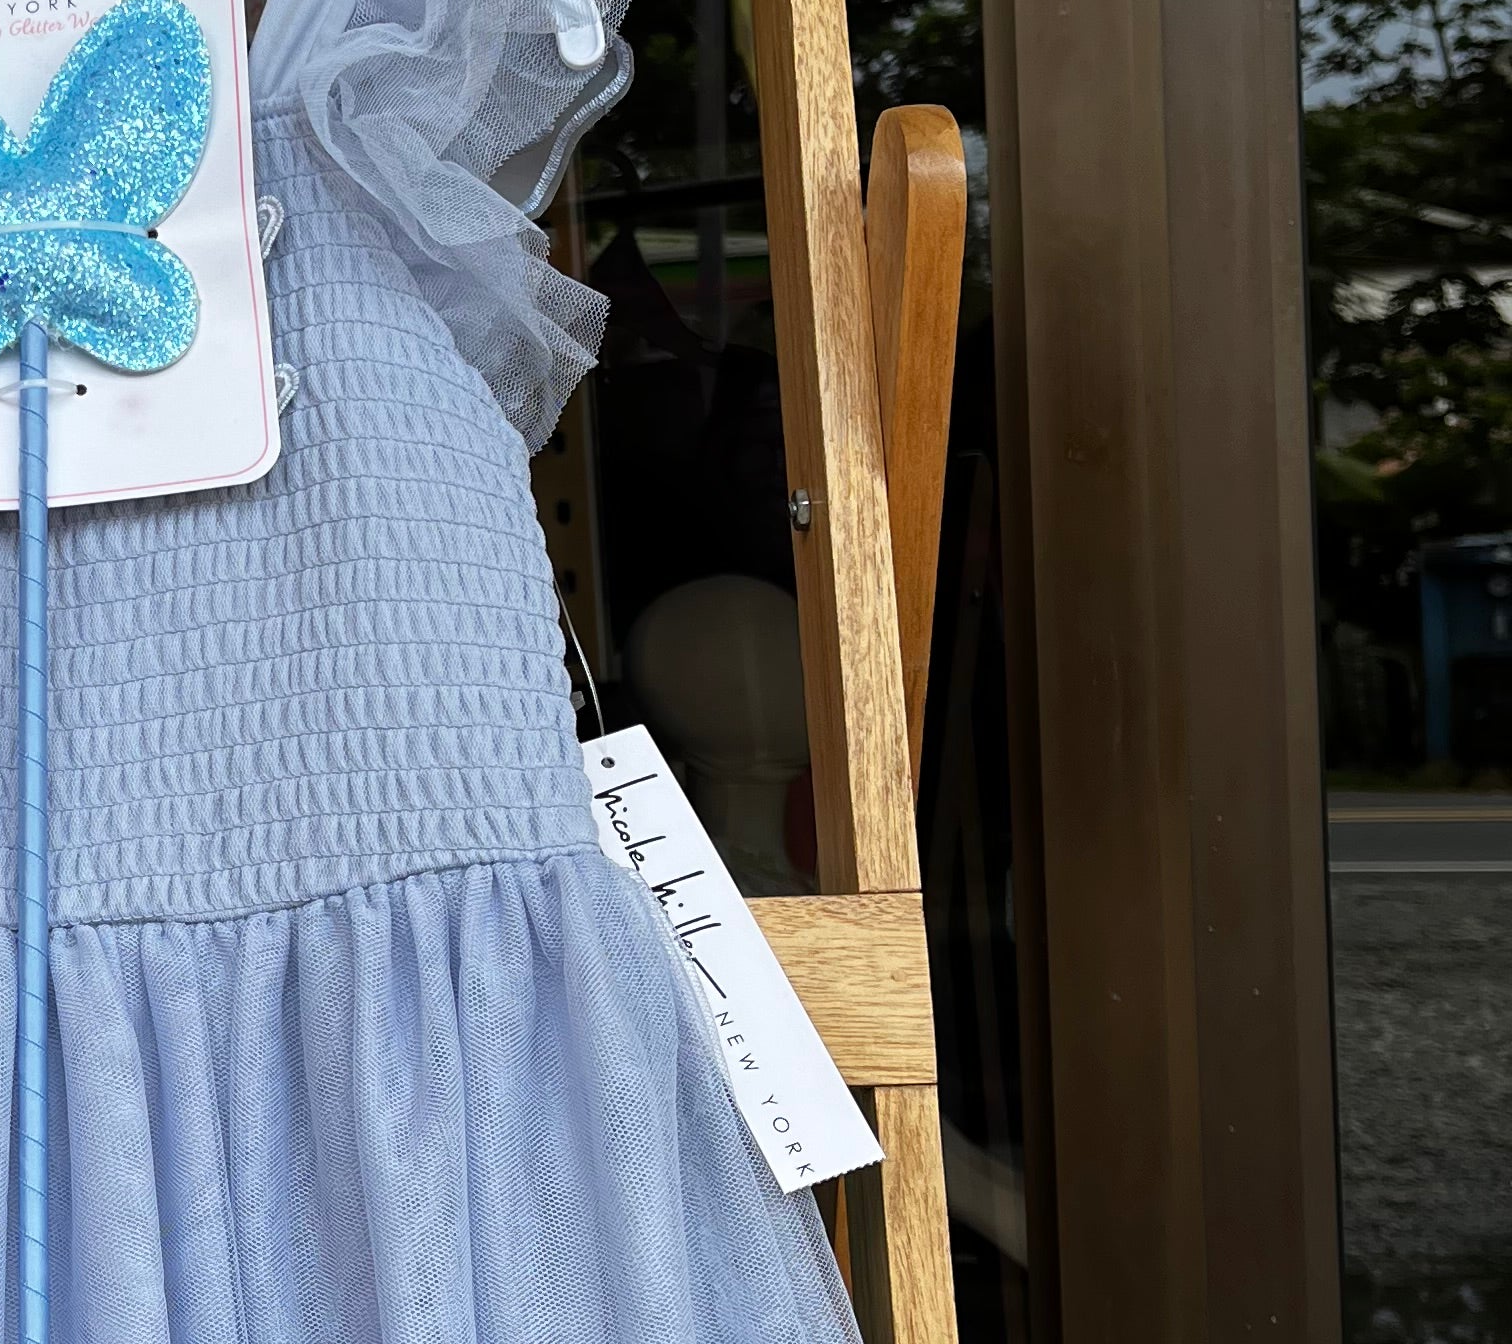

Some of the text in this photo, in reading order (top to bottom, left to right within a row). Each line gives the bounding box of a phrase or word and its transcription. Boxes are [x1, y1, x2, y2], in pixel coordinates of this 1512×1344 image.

[9, 17, 64, 37] Glitter
[715, 1011, 759, 1071] NEW
[761, 1093, 815, 1178] YORK
